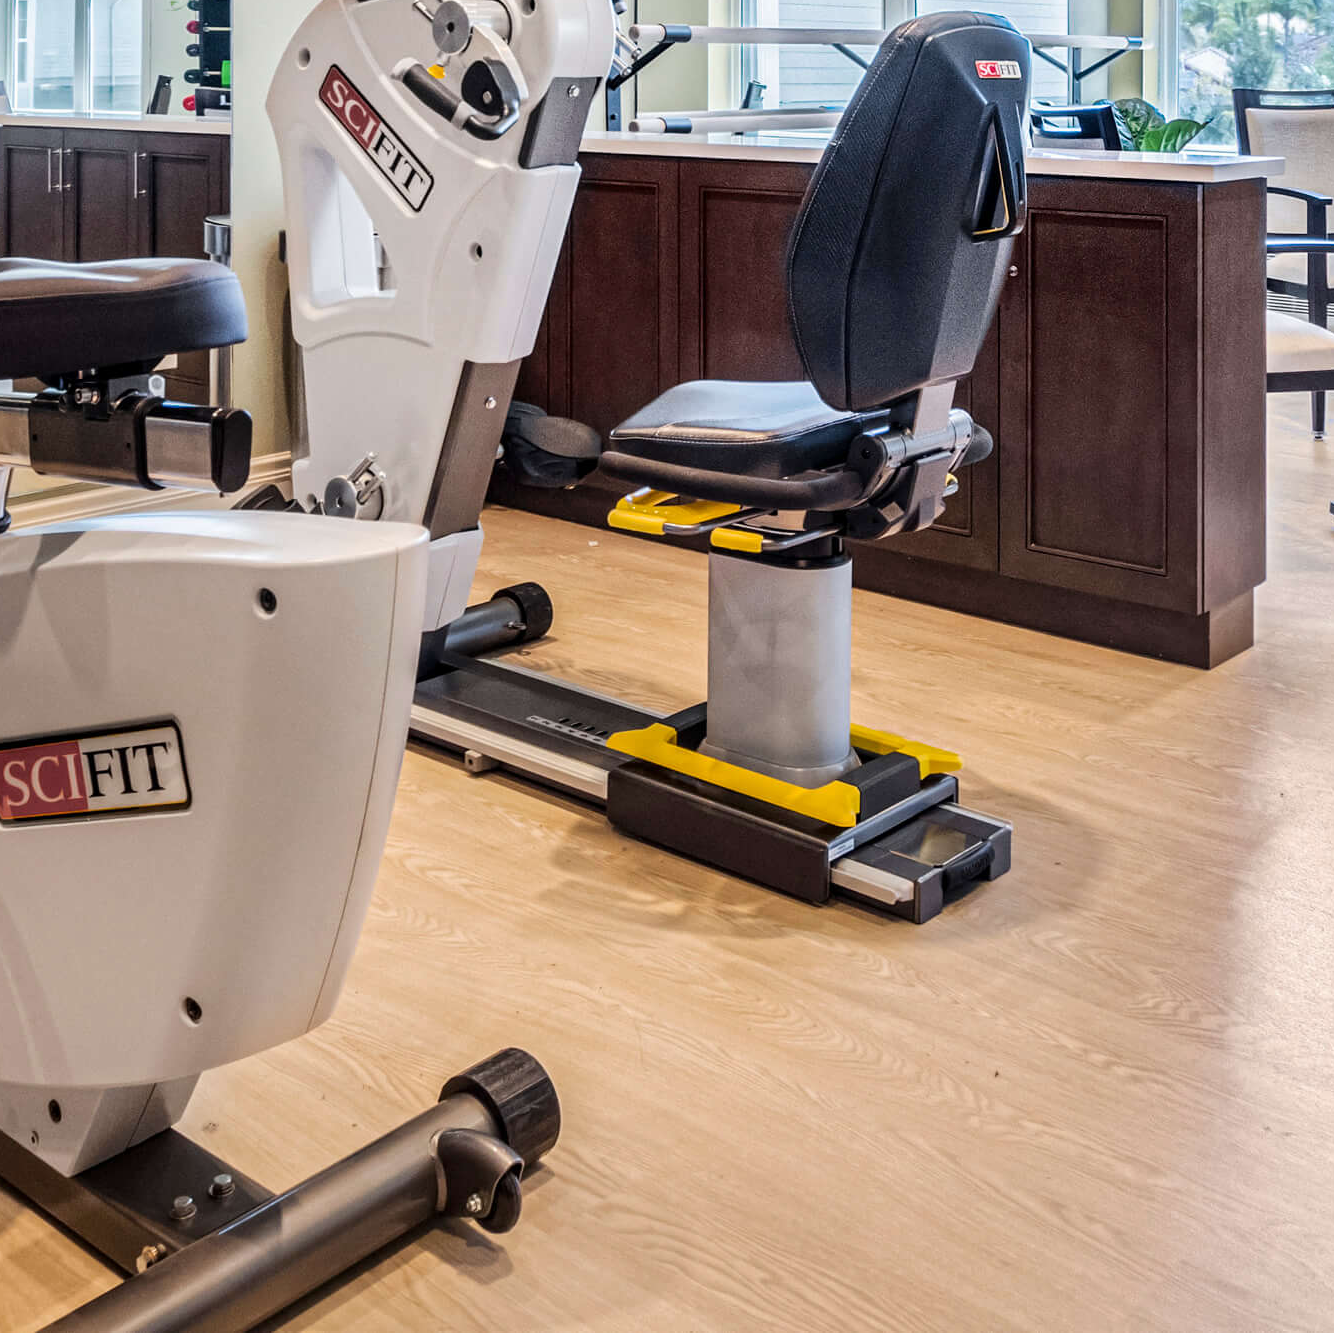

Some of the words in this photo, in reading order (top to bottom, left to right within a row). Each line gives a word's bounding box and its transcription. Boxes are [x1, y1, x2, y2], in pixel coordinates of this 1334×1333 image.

[979, 64, 1017, 76] SCIFIT
[327, 80, 425, 193] SCIFIT
[2, 741, 169, 807] SCIFIT
